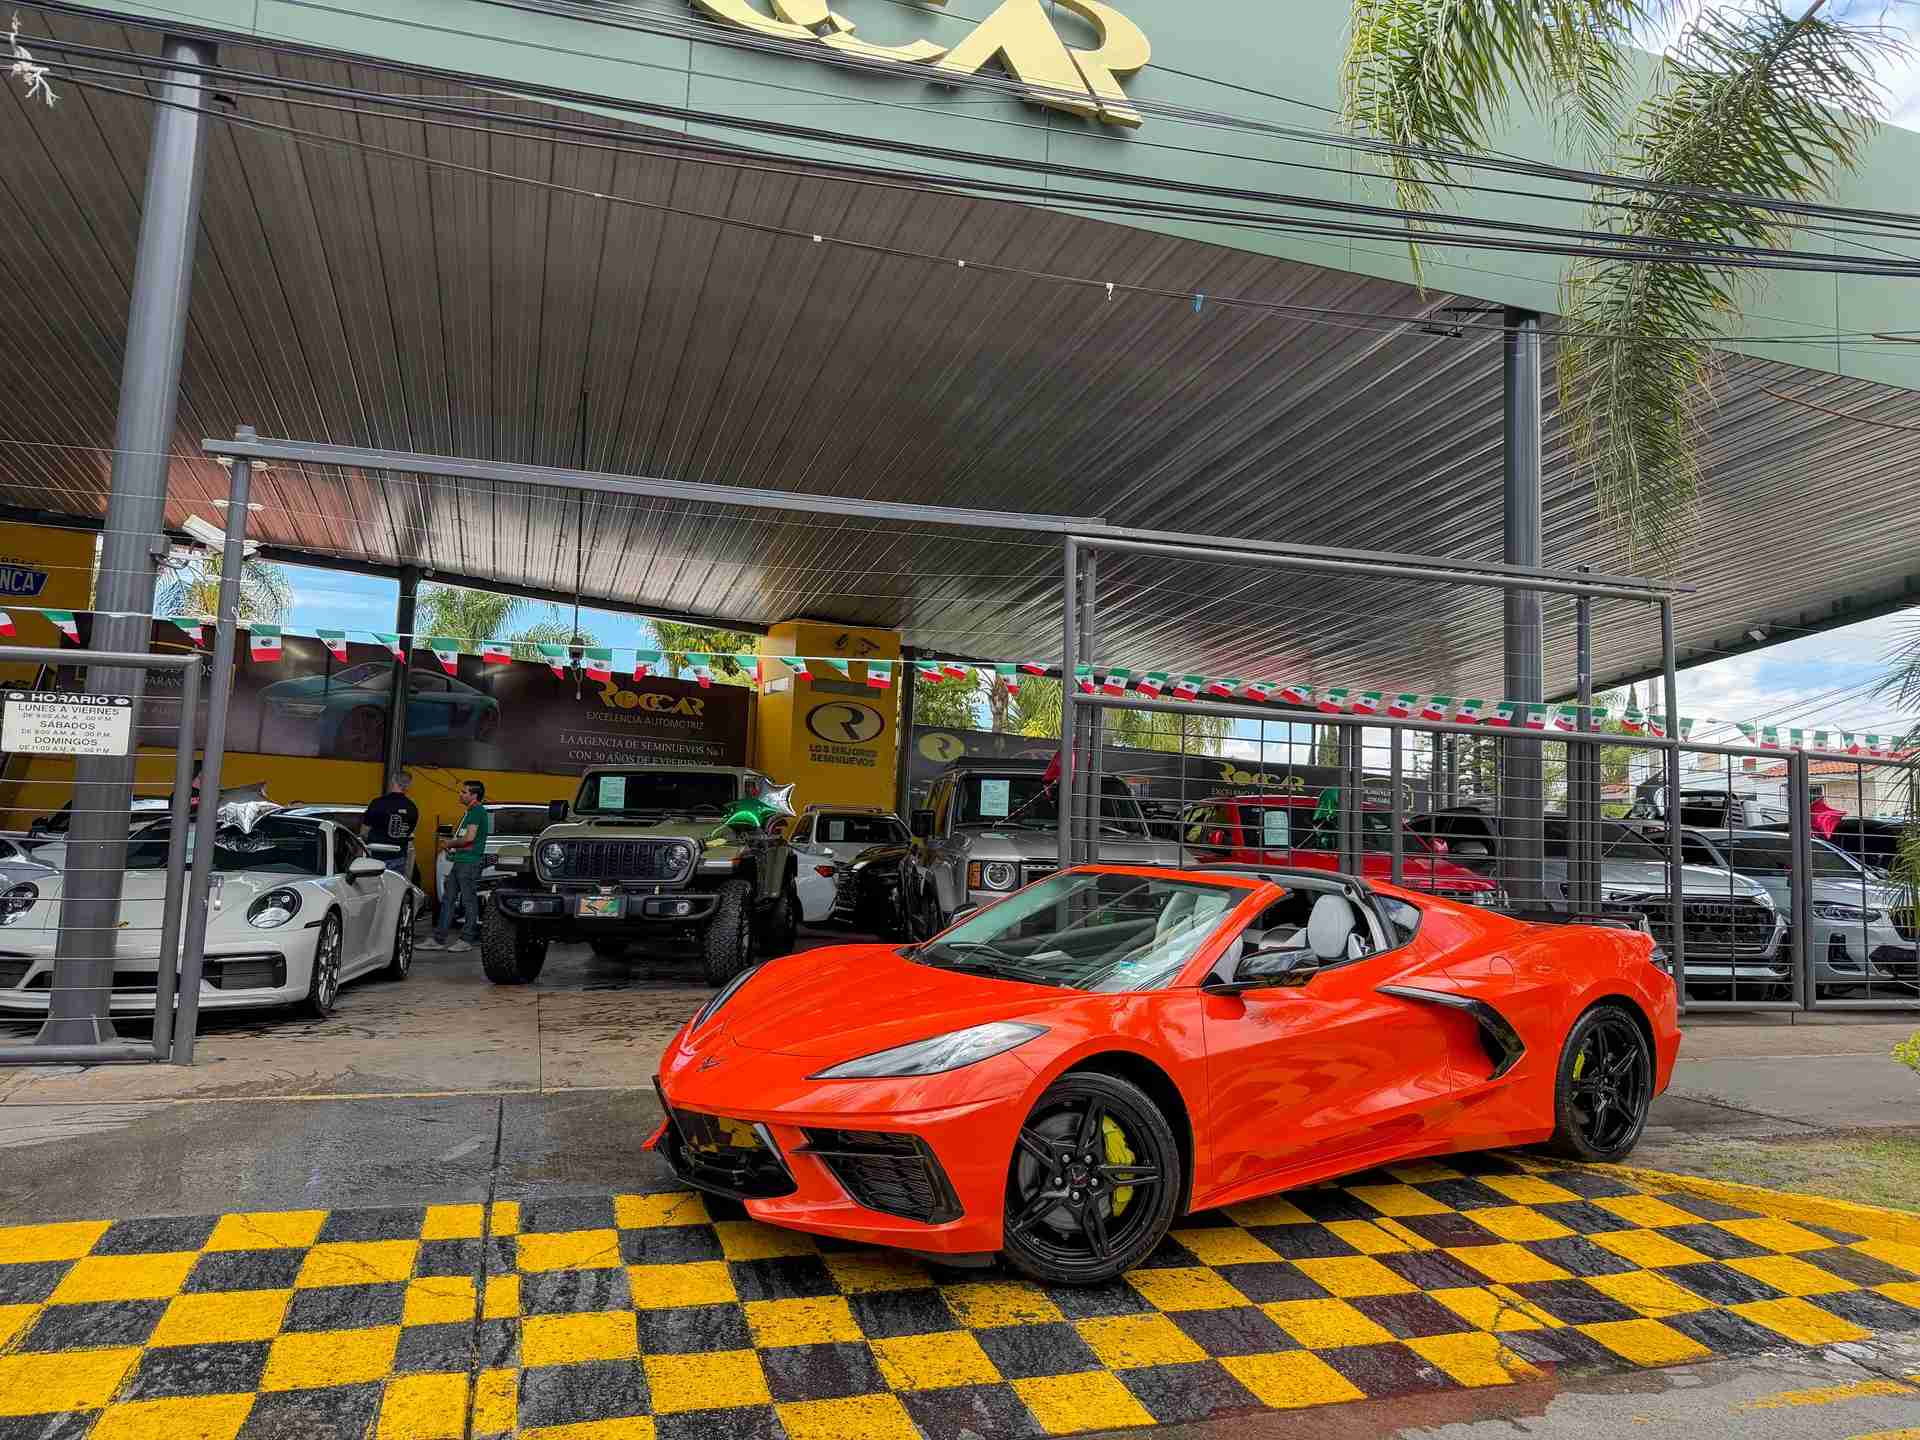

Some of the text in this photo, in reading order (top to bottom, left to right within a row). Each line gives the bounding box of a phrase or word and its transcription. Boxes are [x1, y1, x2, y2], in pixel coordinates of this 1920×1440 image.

[31, 692, 110, 705] HORARIO
[18, 703, 120, 716] LUNES A VIERNES
[39, 720, 96, 730] SABADOS
[644, 716, 705, 729] AUTOMOTRIZ
[34, 736, 98, 746] DOMINGOS
[559, 733, 576, 745] LA
[576, 735, 624, 749] AGENCIA
[624, 738, 639, 750] DE
[640, 740, 704, 753] SEMINUEVOS
[808, 743, 830, 753] LOS
[568, 751, 592, 761] CON
[809, 753, 876, 767] SEMINUEVOS
